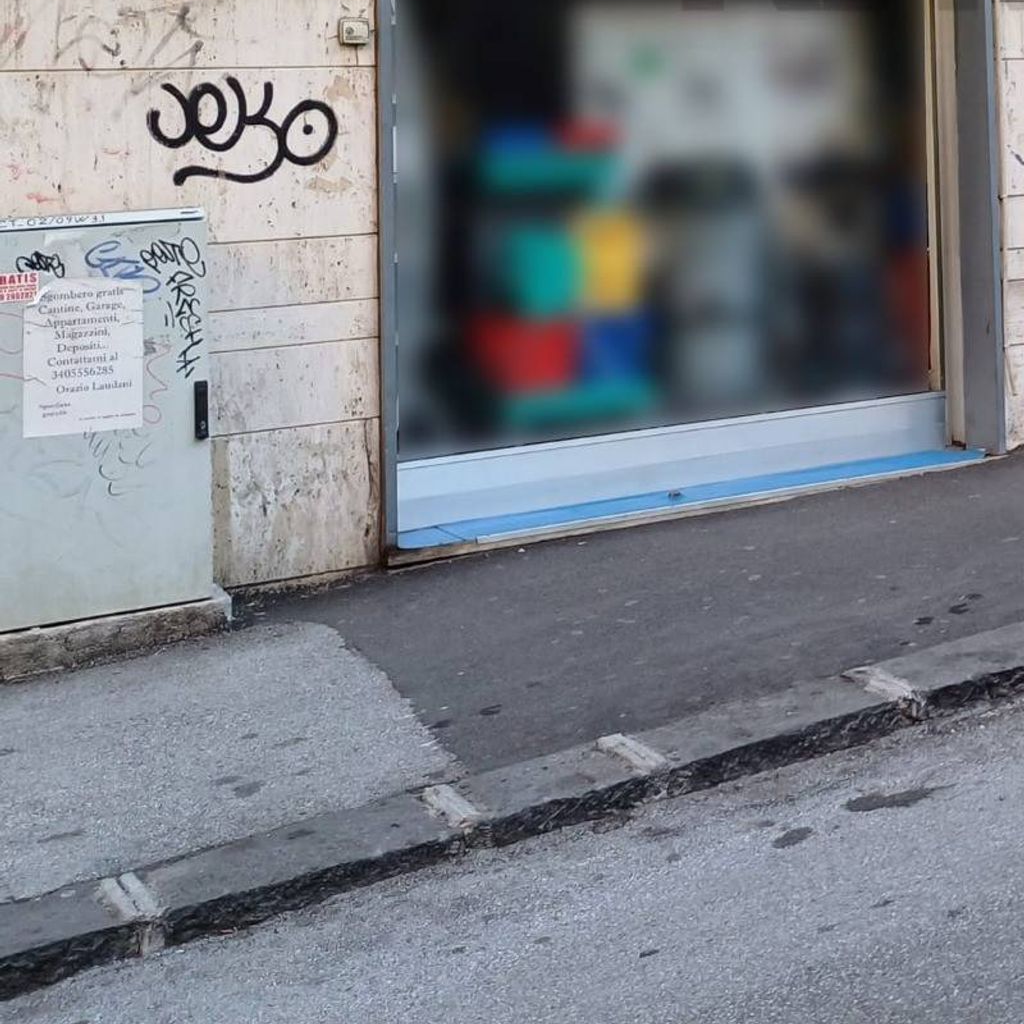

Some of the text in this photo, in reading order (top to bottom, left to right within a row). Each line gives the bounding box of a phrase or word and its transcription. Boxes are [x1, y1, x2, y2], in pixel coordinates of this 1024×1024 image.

[0, 272, 37, 285] RATIS
[38, 301, 126, 314] Cantine, Garage,
[47, 352, 118, 366] Contattami al
[56, 384, 89, 393] Orazio
